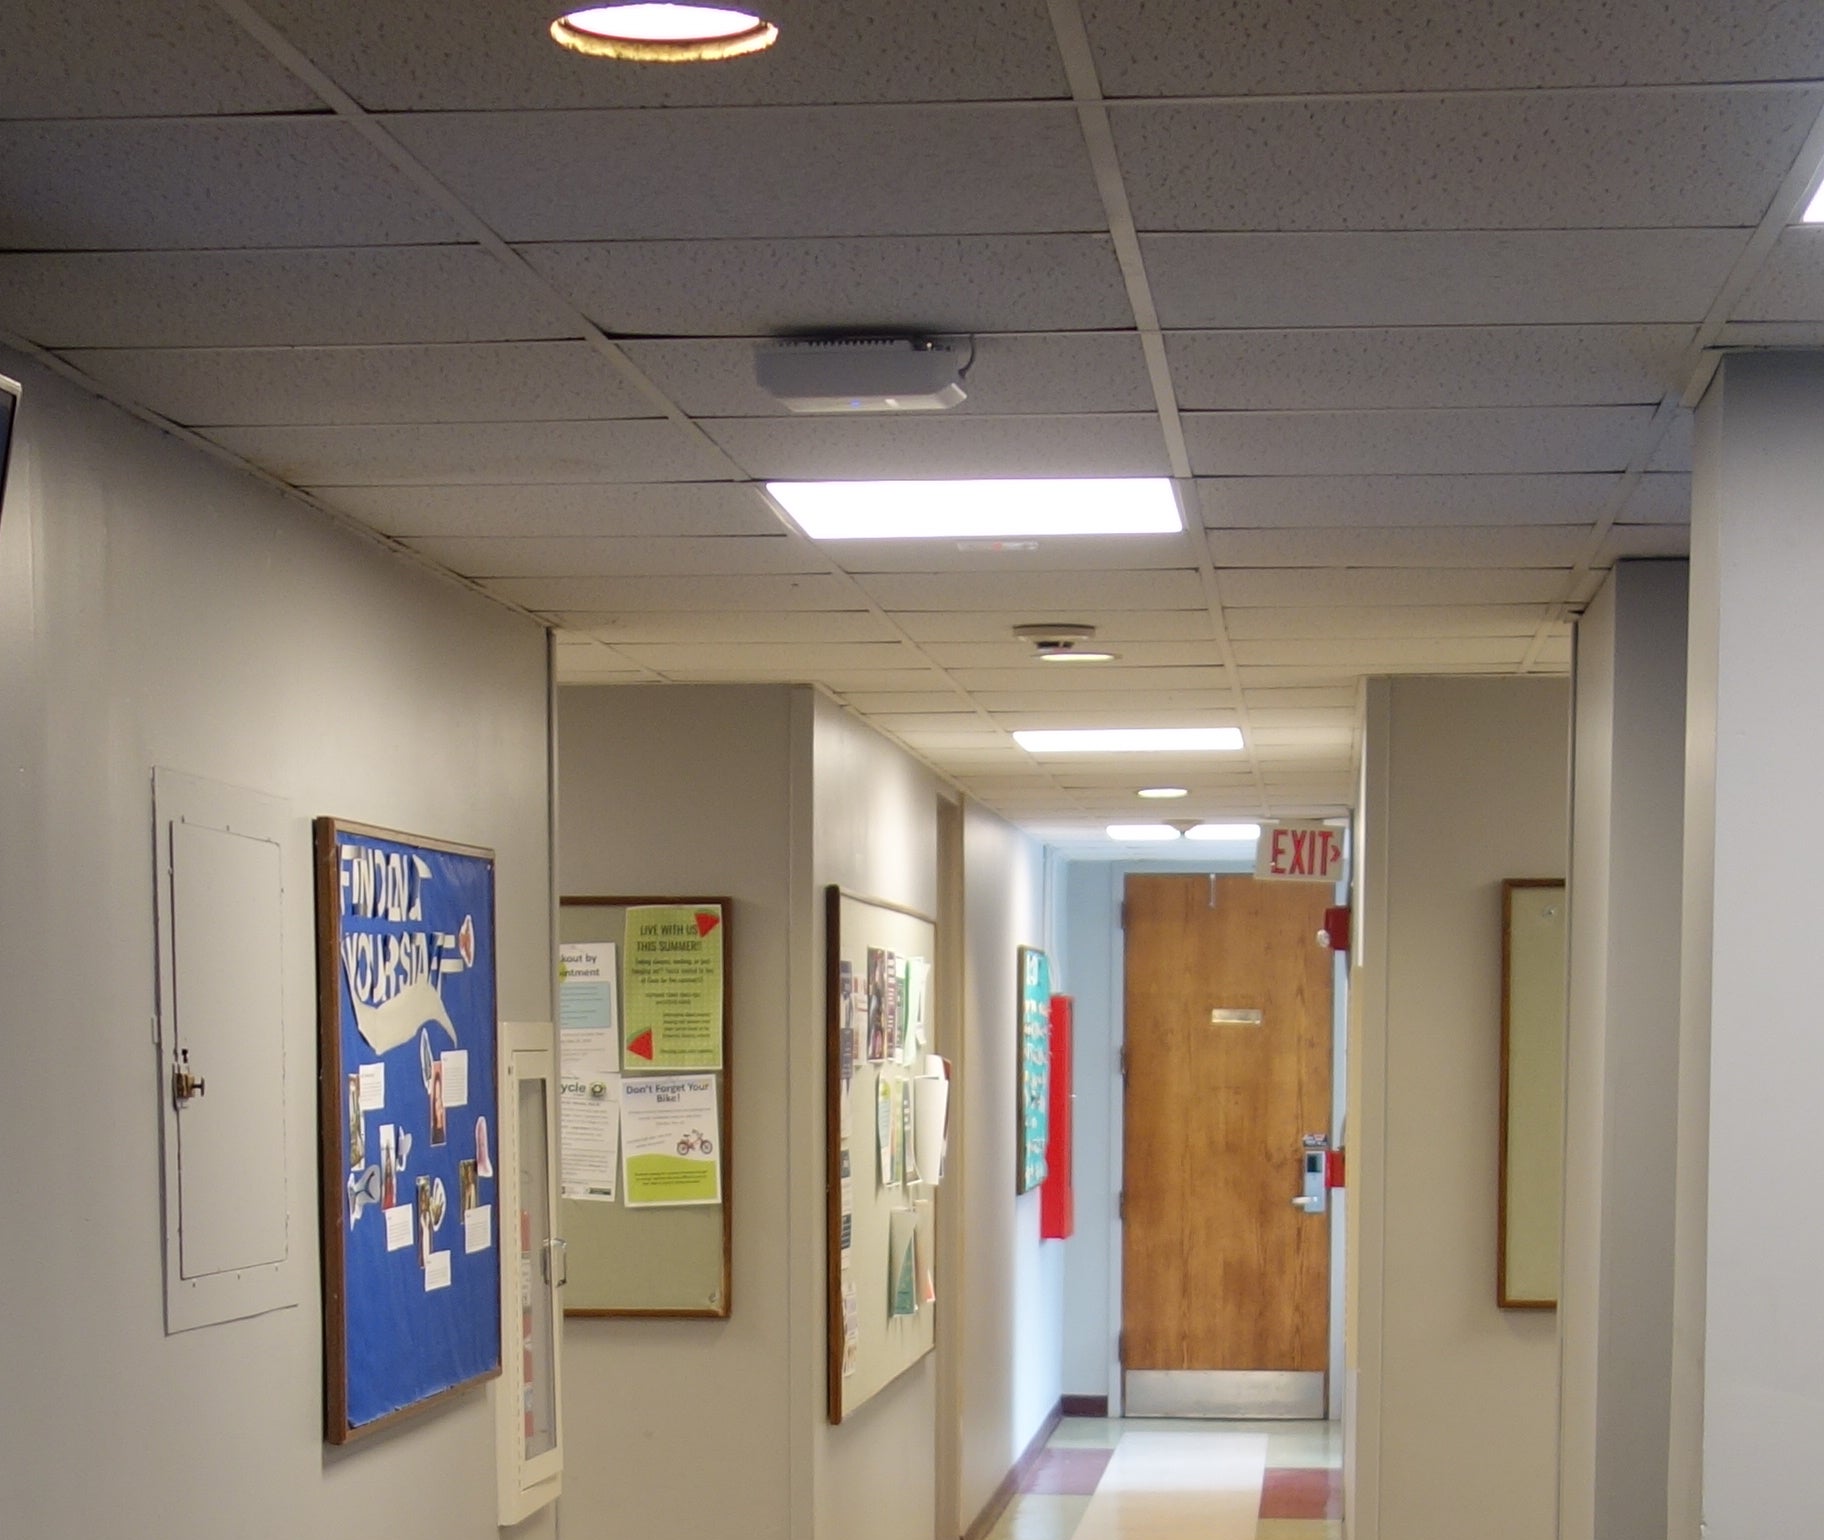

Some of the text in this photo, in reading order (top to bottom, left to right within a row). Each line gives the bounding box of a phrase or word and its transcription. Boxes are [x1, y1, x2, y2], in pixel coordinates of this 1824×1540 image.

[1271, 829, 1334, 877] EXIT
[640, 924, 657, 936] LIVE
[661, 924, 683, 936] WITH
[637, 941, 656, 952] THIS
[585, 953, 597, 965] by
[626, 1082, 709, 1095] Don't Forget Your
[657, 1093, 680, 1103] Bike!
